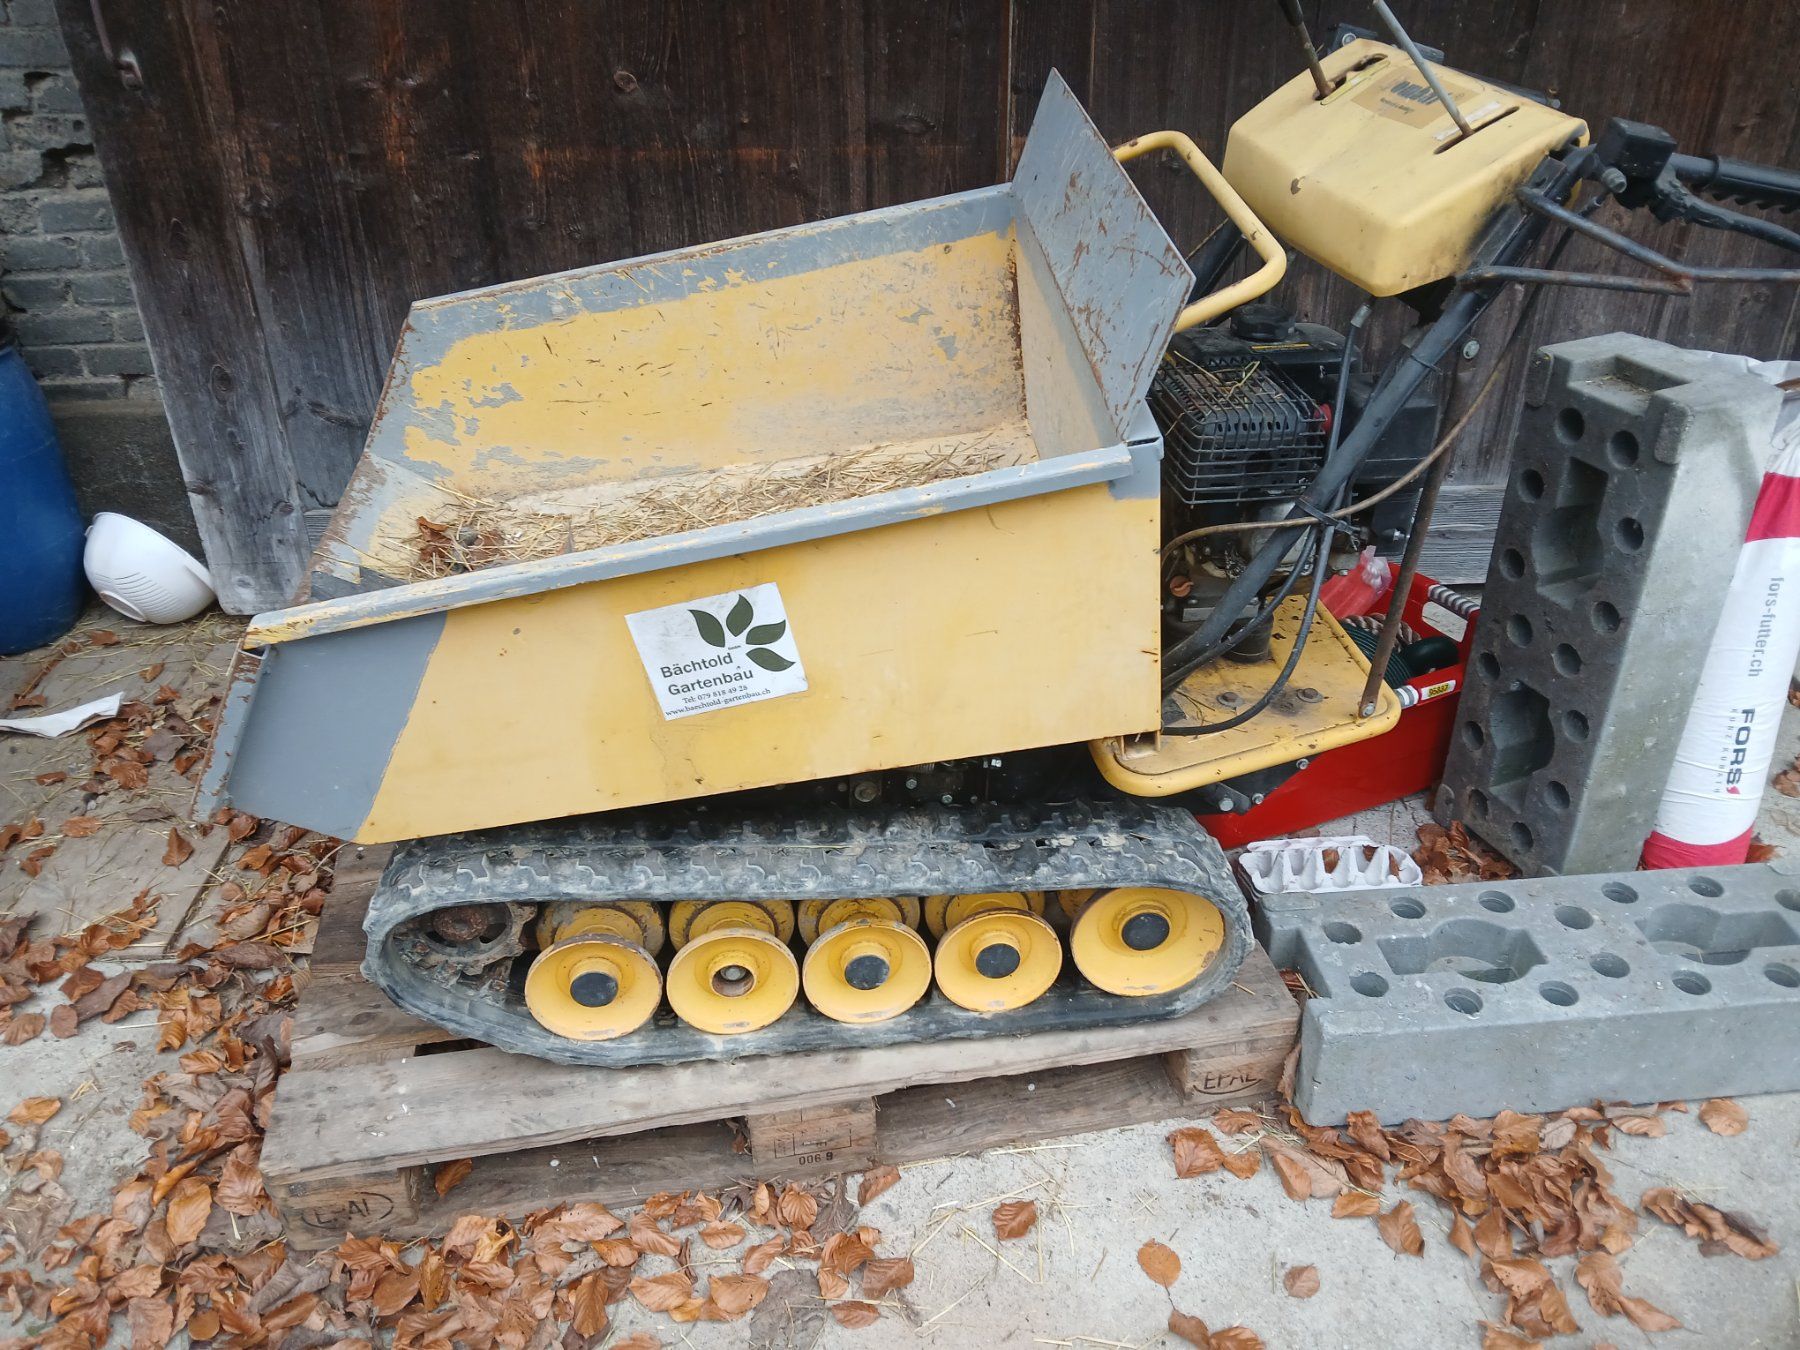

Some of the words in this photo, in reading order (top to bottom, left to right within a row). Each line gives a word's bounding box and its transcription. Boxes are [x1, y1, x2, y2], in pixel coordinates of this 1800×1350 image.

[1747, 577, 1784, 677] fors-futter.ch
[660, 652, 733, 678] Bächtold
[668, 669, 754, 696] Gartenbau
[665, 688, 771, 716] www.baechtold-gartenbau.ch
[682, 696, 697, 704] Tel:
[697, 692, 711, 701] 079
[1727, 708, 1755, 785] FORS
[799, 1153, 821, 1166] 006
